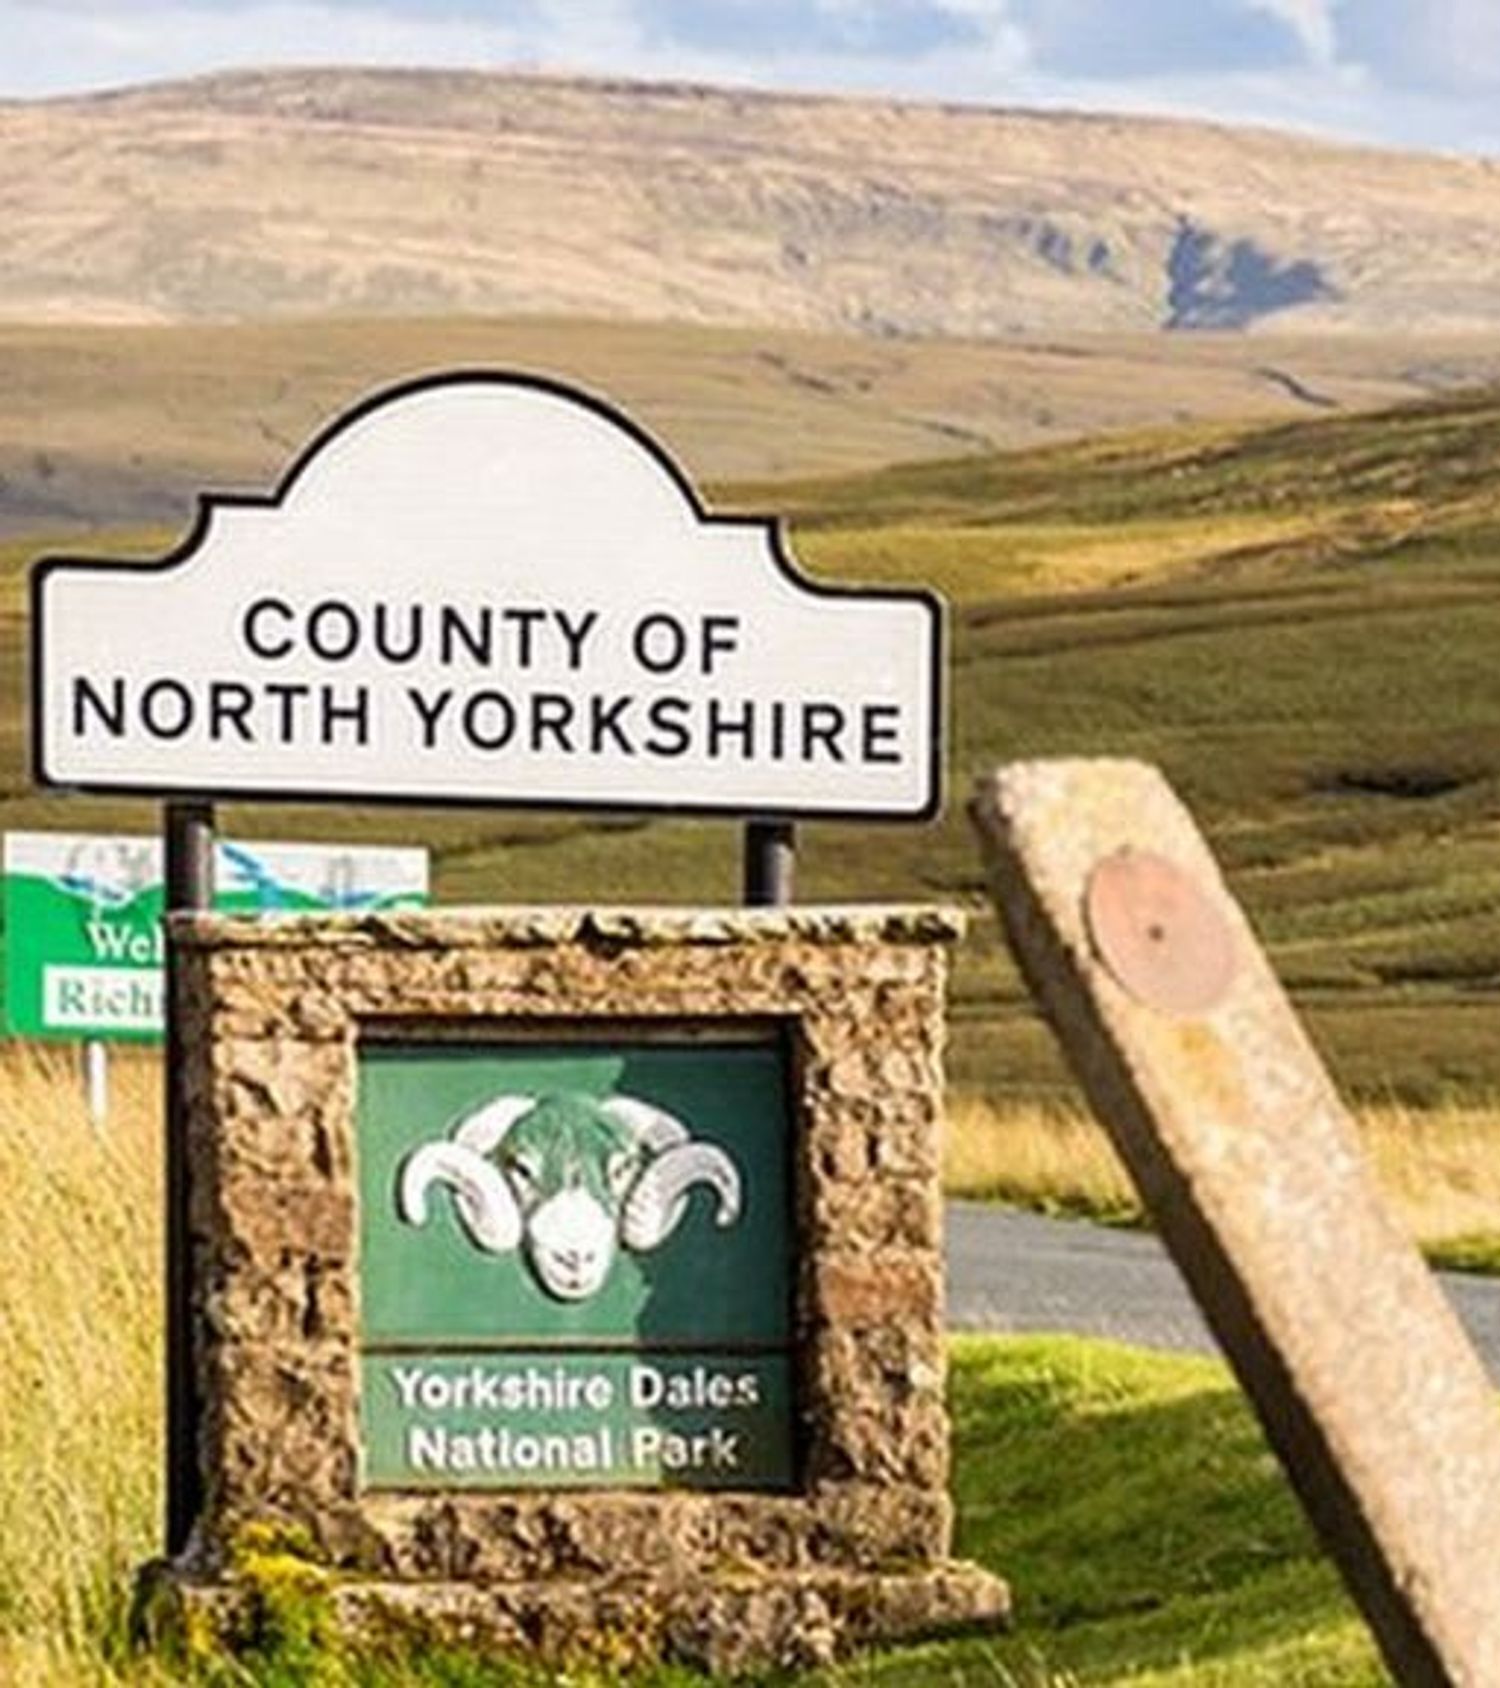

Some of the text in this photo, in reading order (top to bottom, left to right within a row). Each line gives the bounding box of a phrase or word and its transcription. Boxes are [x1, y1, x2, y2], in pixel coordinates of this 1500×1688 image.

[243, 599, 739, 674] COUNTY OF
[72, 679, 902, 764] NORTH YORKSHIRE
[57, 977, 164, 1017] Rich
[392, 1367, 759, 1411] Yorkshire Dales
[410, 1425, 739, 1470] National Park
